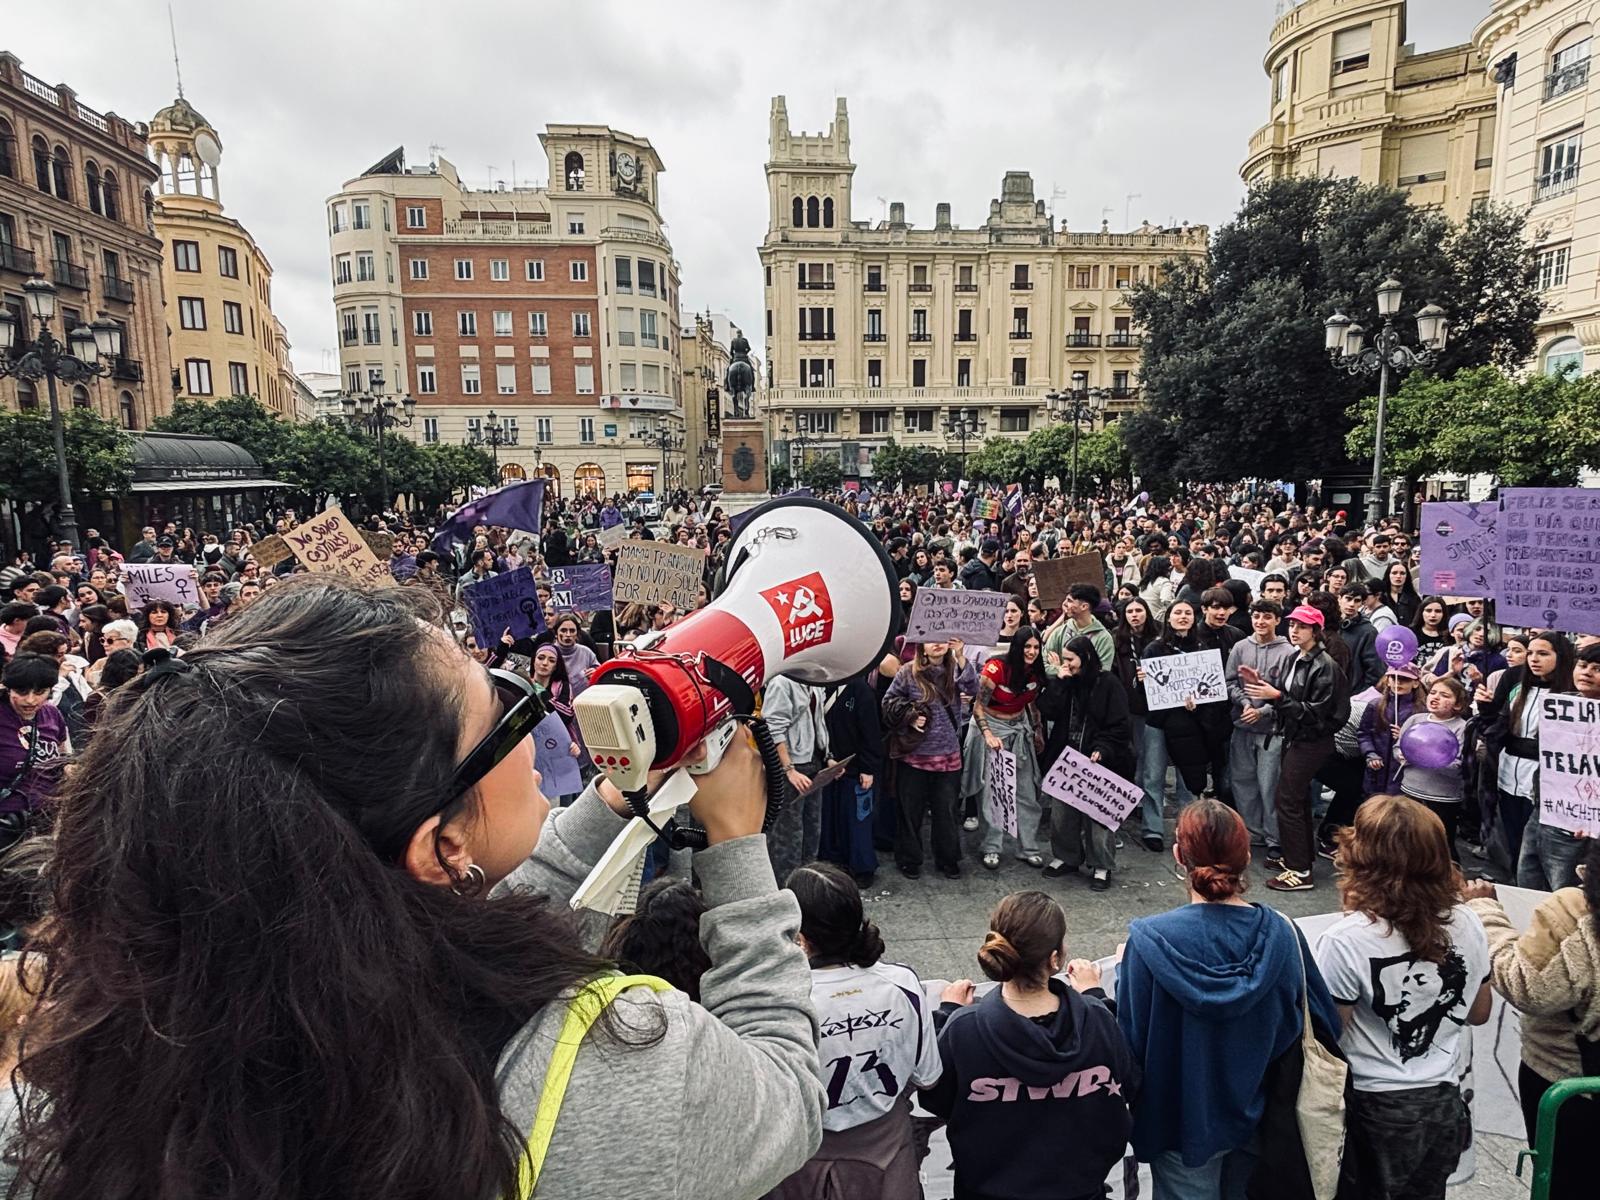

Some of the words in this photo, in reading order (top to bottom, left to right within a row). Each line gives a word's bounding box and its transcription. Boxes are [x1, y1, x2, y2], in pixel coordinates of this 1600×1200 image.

[1507, 512, 1528, 527] EL
[1536, 532, 1588, 547] TENGA
[654, 550, 702, 574] TRANQUILA
[127, 566, 175, 585] MILES
[554, 570, 564, 584] 8
[652, 568, 672, 586] VOY
[674, 572, 700, 593] SOLA
[615, 581, 640, 600] POR
[646, 587, 659, 602] LA
[1547, 595, 1559, 610] A
[1543, 698, 1575, 723] SI
[1005, 757, 1015, 777] NO
[1060, 781, 1074, 793] LA
